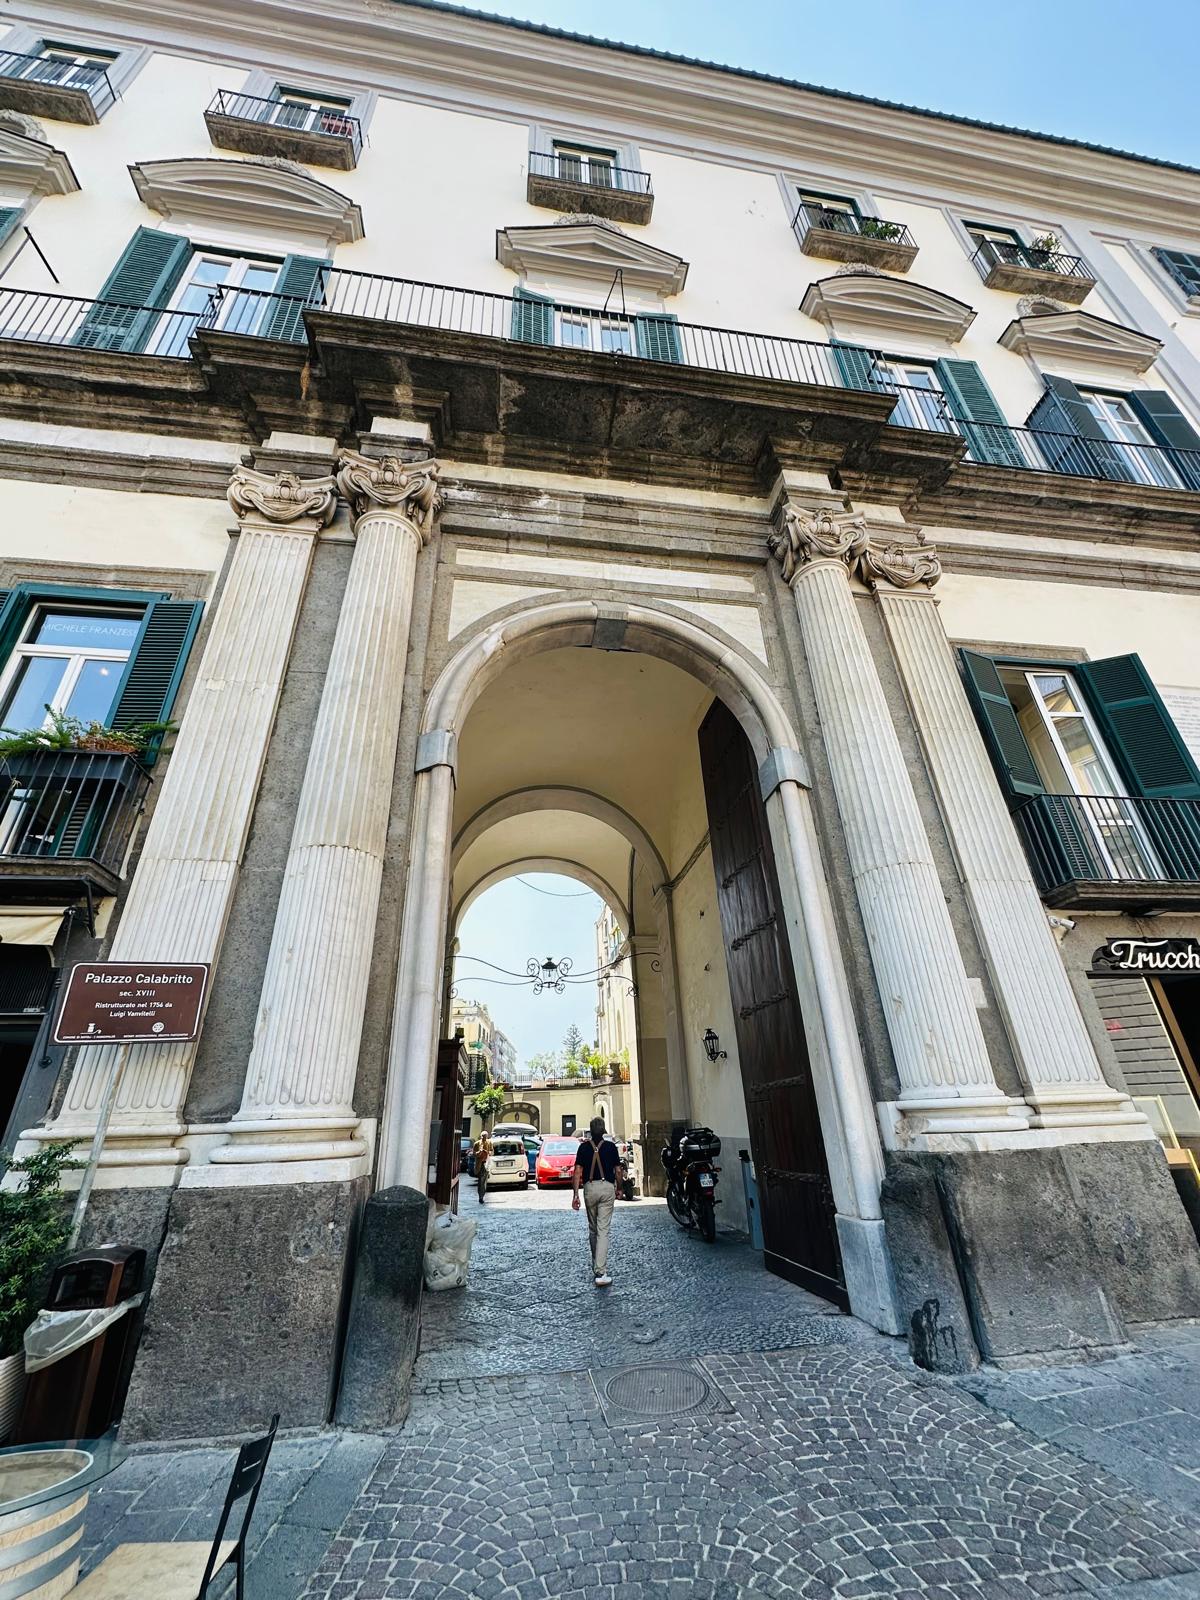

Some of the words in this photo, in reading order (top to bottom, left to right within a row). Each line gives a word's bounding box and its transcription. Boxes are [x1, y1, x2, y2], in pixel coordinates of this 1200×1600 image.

[84, 973, 132, 984] Palazzo
[135, 973, 193, 984] Calabritto
[109, 1010, 126, 1018] Luigi
